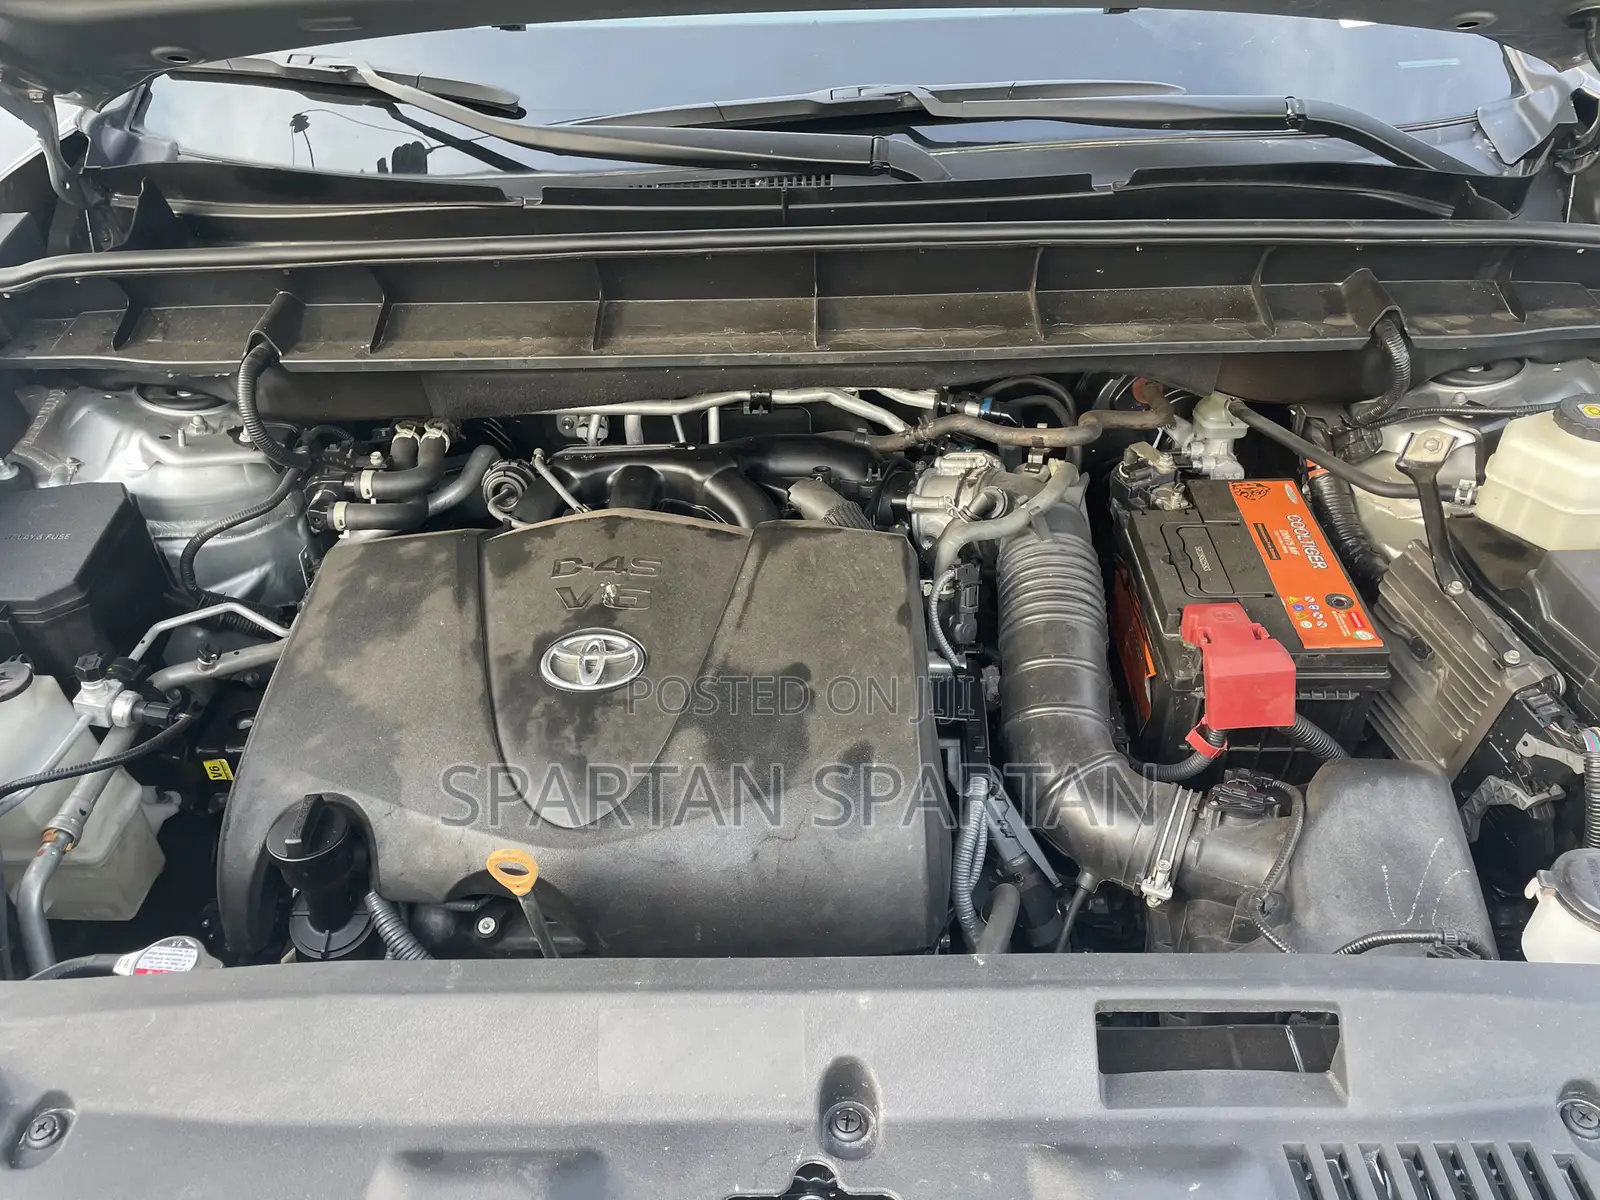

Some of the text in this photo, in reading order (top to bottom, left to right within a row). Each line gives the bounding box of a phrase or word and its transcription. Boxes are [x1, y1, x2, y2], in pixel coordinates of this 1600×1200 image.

[45, 531, 72, 541] FUSE
[1286, 514, 1328, 569] COOLTIGER
[551, 556, 663, 579] D-4S
[555, 583, 652, 610] V6
[209, 765, 222, 778] V6
